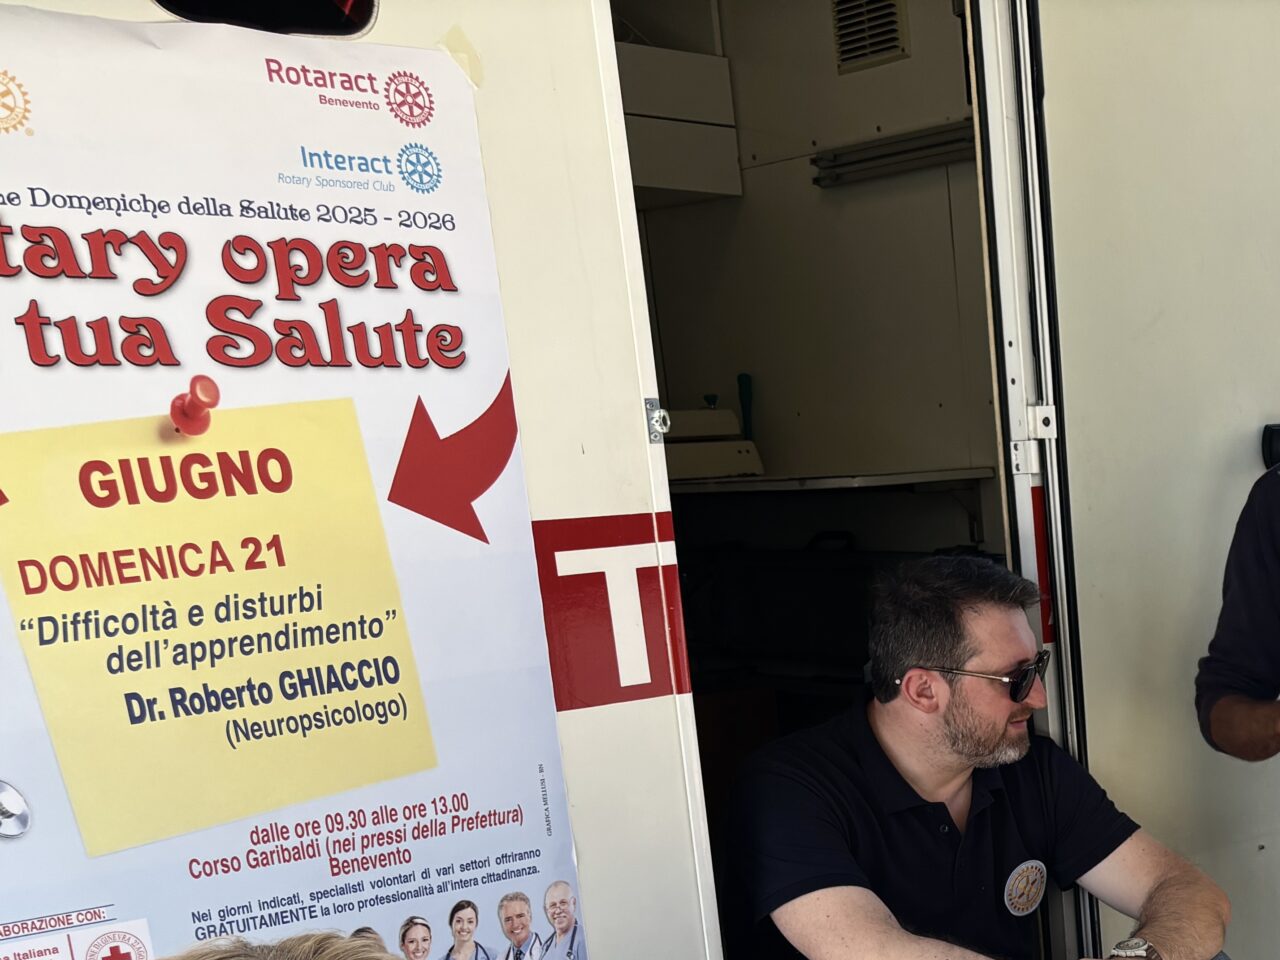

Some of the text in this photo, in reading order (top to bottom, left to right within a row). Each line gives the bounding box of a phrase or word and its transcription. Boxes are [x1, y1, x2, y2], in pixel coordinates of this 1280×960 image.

[265, 57, 379, 94] Rotaract
[319, 94, 380, 111] Benevento
[277, 172, 312, 188] Rotary
[315, 175, 369, 191] Sponsored
[372, 179, 396, 193] Club
[300, 145, 393, 175] Interact
[27, 187, 171, 218] Domeniche
[178, 196, 234, 217] della
[239, 199, 311, 222] Salute
[316, 204, 378, 226] 2025
[398, 210, 456, 231] 2026
[222, 235, 459, 301] opera
[15, 295, 467, 369] tua Salute
[78, 447, 293, 508] GIUGNO
[18, 534, 286, 595] DOMENICA 21
[188, 603, 204, 626] e
[214, 583, 322, 623] disturbi
[124, 656, 400, 725] Dr. Roberto GHIACCIO
[225, 692, 407, 749] (Neuropsicologo)
[188, 804, 524, 879] Corso Garibaldi (nei pressi della Prefettura)
[250, 792, 469, 846] dalle ore 09.30 alle ore 13.00
[191, 848, 541, 924] Nei giorni indicati, specialisti volontari di vari settori offriranno
[329, 847, 412, 877] Benevento
[76, 908, 106, 924] CON:
[195, 905, 318, 941] GRATUITAMENTE
[320, 905, 331, 917] la
[333, 899, 355, 915] loro
[358, 883, 434, 912] professionalità
[481, 864, 540, 885] cittadinanza.
